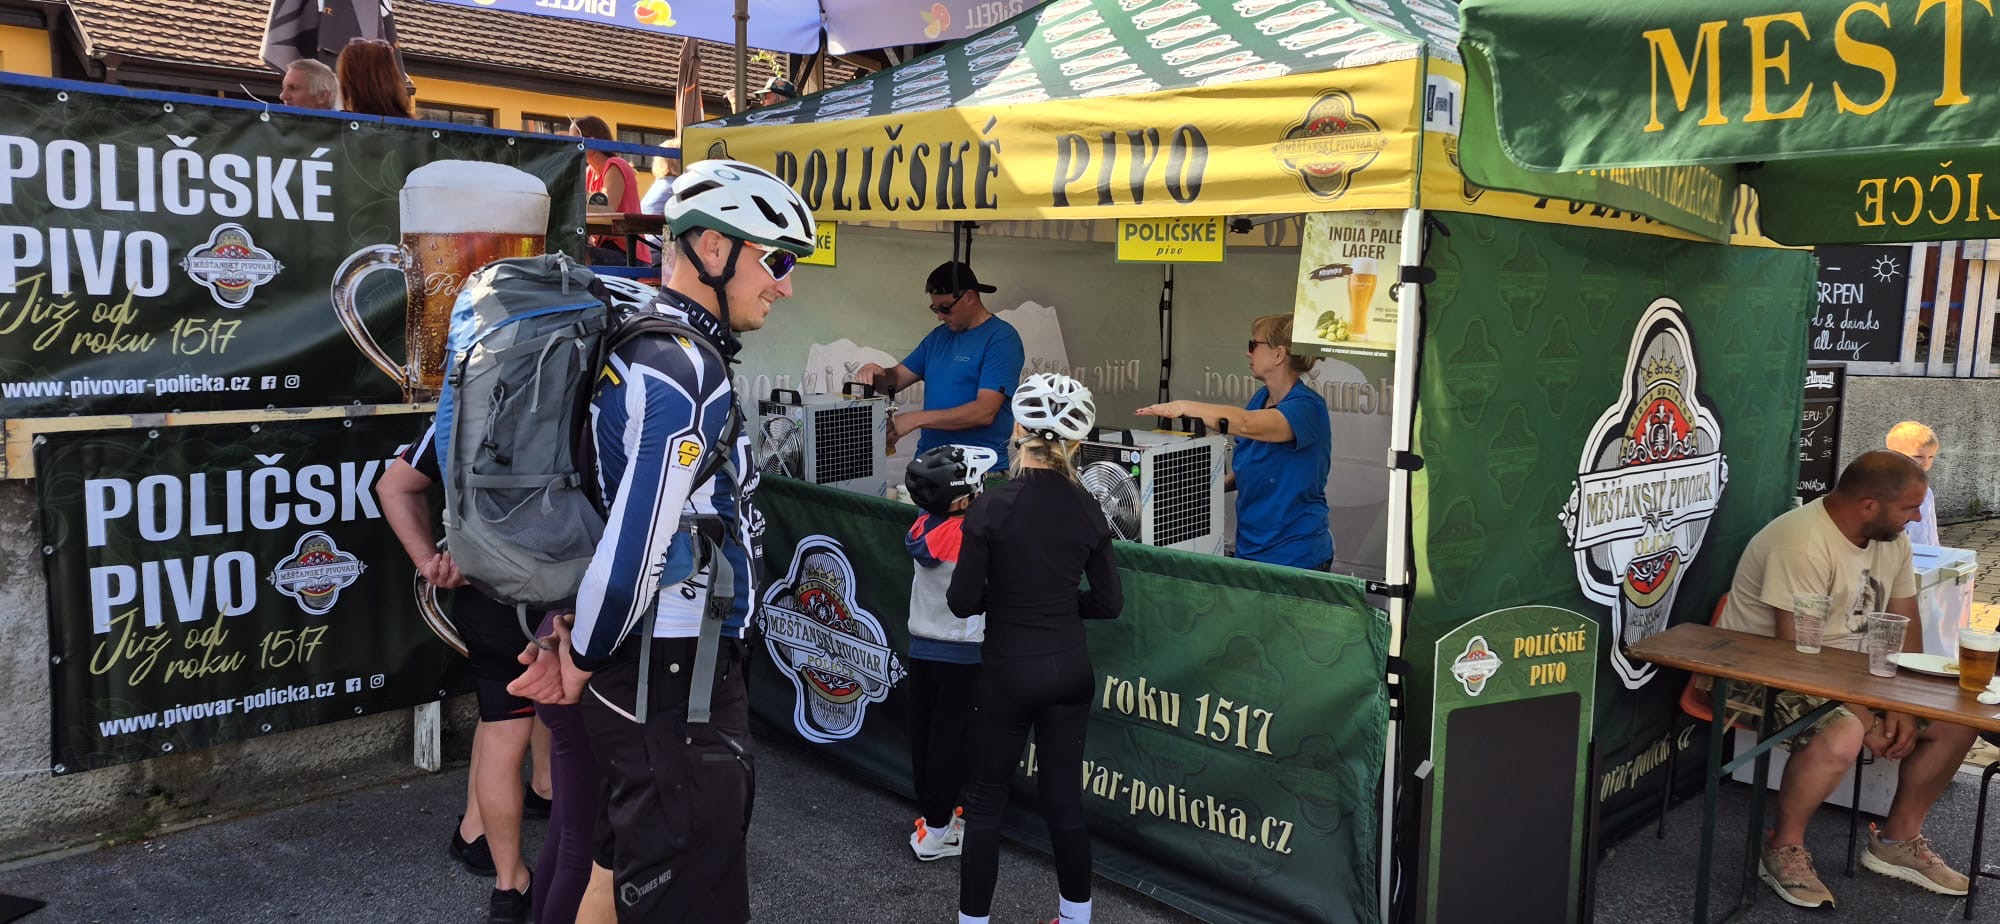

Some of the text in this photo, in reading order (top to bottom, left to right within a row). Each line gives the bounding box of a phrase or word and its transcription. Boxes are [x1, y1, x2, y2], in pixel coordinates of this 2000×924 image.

[0, 134, 334, 222] POLIČSKÉ
[776, 115, 1209, 212] POLIČSKÉ PIVO
[1125, 218, 1217, 242] POLIČSKÉ
[1156, 245, 1184, 256] pivo
[1329, 226, 1402, 244] INDIA PALE
[1342, 243, 1386, 260] LAGER
[0, 225, 170, 297] PIVO
[0, 272, 138, 351] Již od
[1825, 313, 1835, 328] &
[1840, 308, 1880, 330] drinks
[71, 318, 242, 355] roku 1517
[1814, 330, 1870, 360] all day
[2, 374, 251, 399] www.pivovar-policka.cz
[85, 444, 411, 547] POLIČSK
[89, 550, 257, 635] PIVO
[89, 601, 229, 687] Již od
[164, 625, 329, 684] roku 1517
[1513, 623, 1587, 659] POLIČSKÉ
[1529, 661, 1567, 687] PIVO
[99, 681, 336, 738] www.pivovar-policka.cz
[1102, 675, 1275, 755] roku 1517
